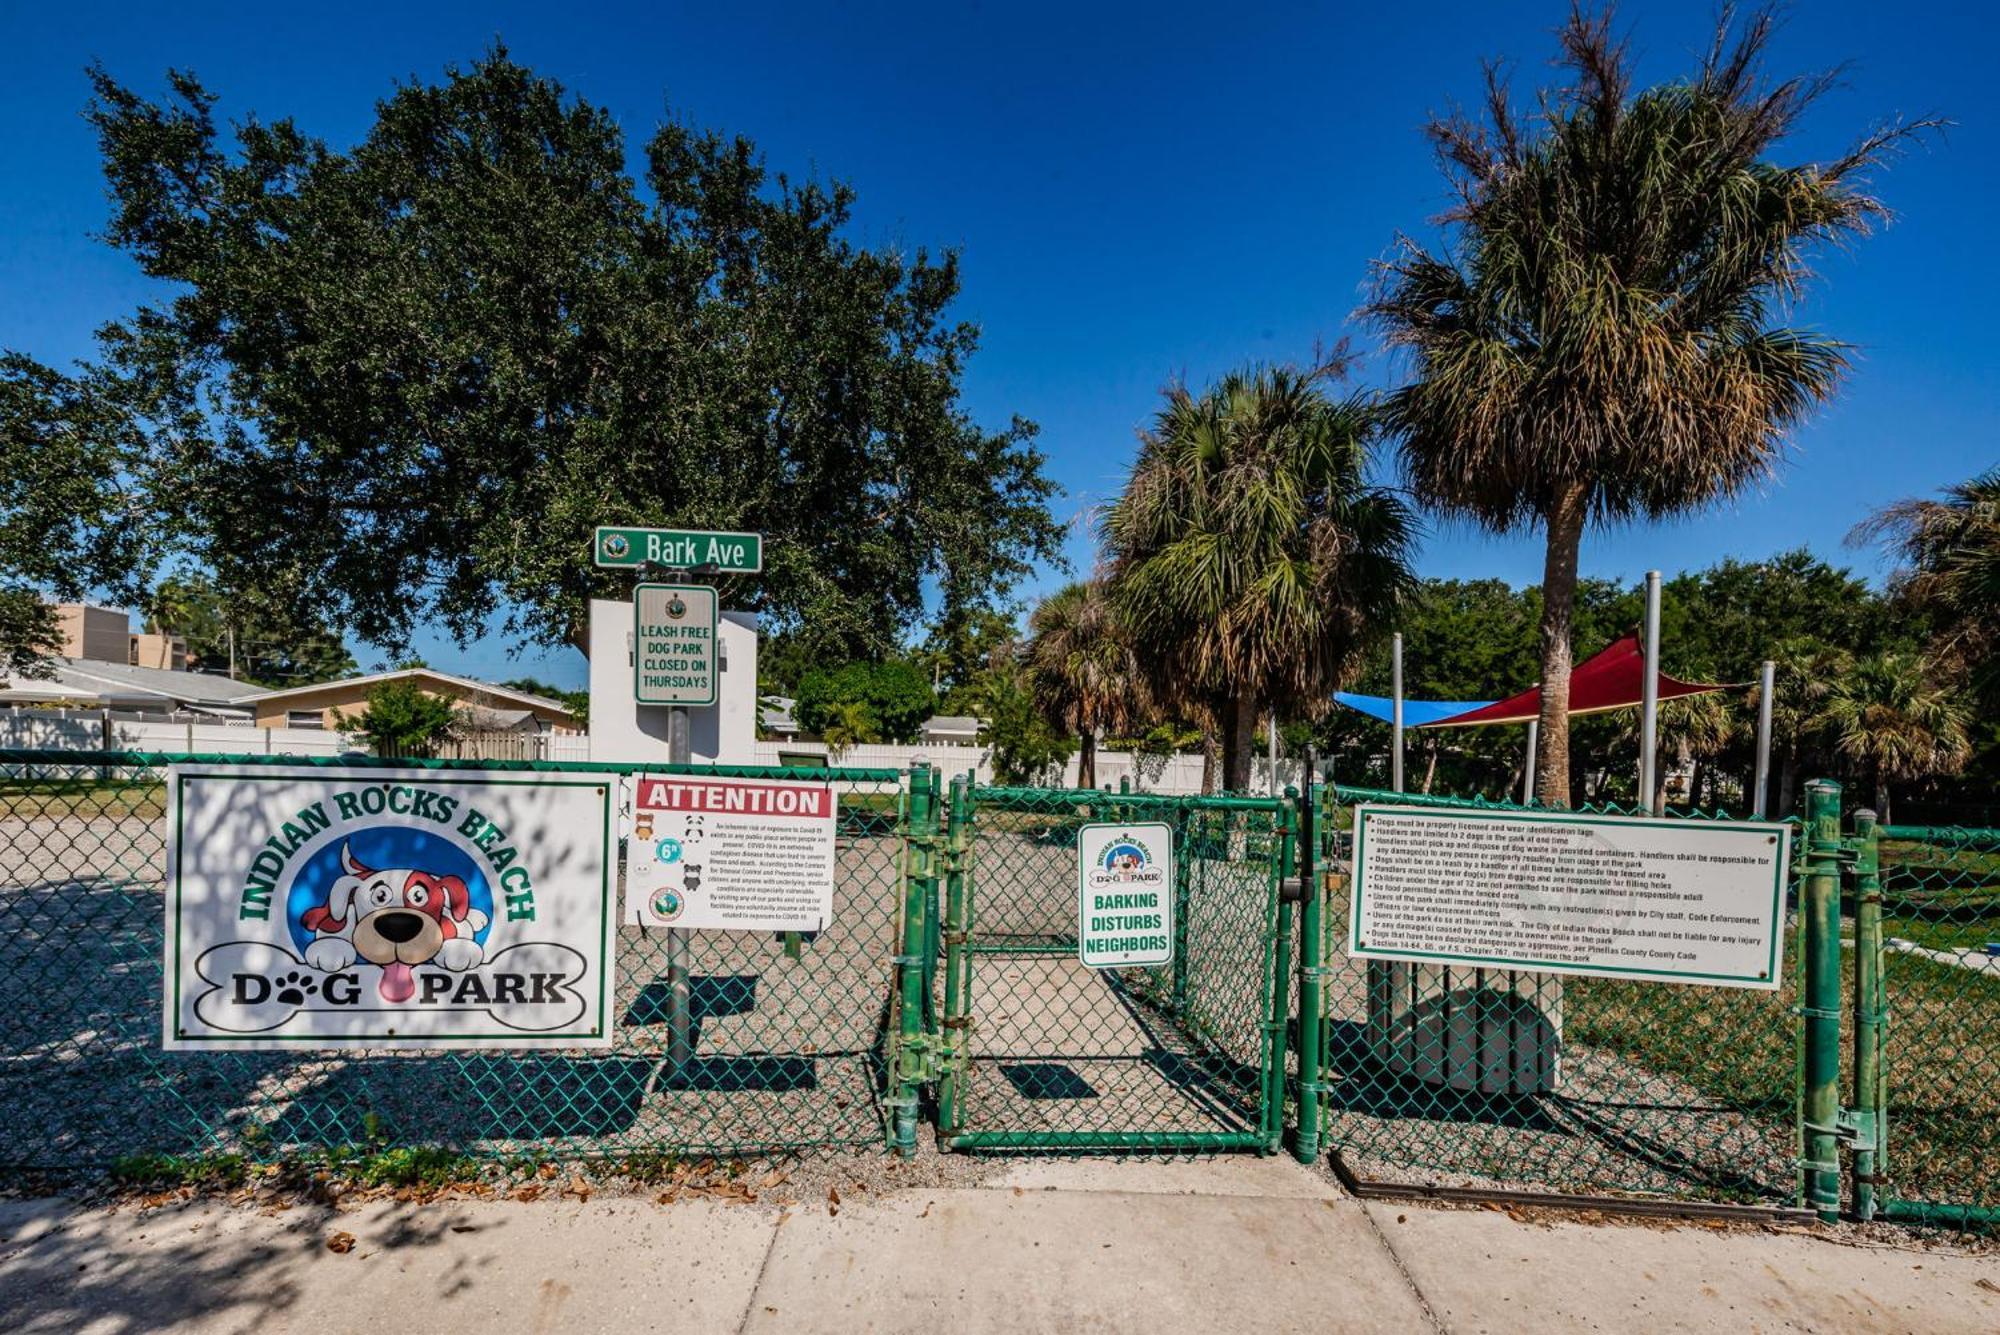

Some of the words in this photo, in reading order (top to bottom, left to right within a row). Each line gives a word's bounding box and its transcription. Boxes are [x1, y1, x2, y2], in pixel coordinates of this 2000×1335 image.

[647, 534, 696, 564] Bark
[706, 537, 744, 566] Ave
[641, 626, 678, 638] LEASH
[680, 627, 710, 638] FREE
[648, 643, 670, 654] DOG
[673, 643, 703, 655] PARK
[645, 660, 688, 671] CLOSED
[692, 660, 706, 671] ON
[643, 676, 708, 688] THURSDAYS
[647, 783, 820, 814] ATTENTION
[240, 802, 334, 922] INDIAN
[333, 786, 459, 824] ROCKS
[457, 808, 536, 923] BEACH
[1096, 874, 1121, 883] DG
[1130, 873, 1159, 882] PARK
[1094, 893, 1158, 910] BARKING
[1091, 914, 1162, 932] DISTURBS
[1086, 935, 1167, 953] NEIGHBORS
[231, 971, 362, 1005] DG
[419, 973, 568, 1004] PARK
